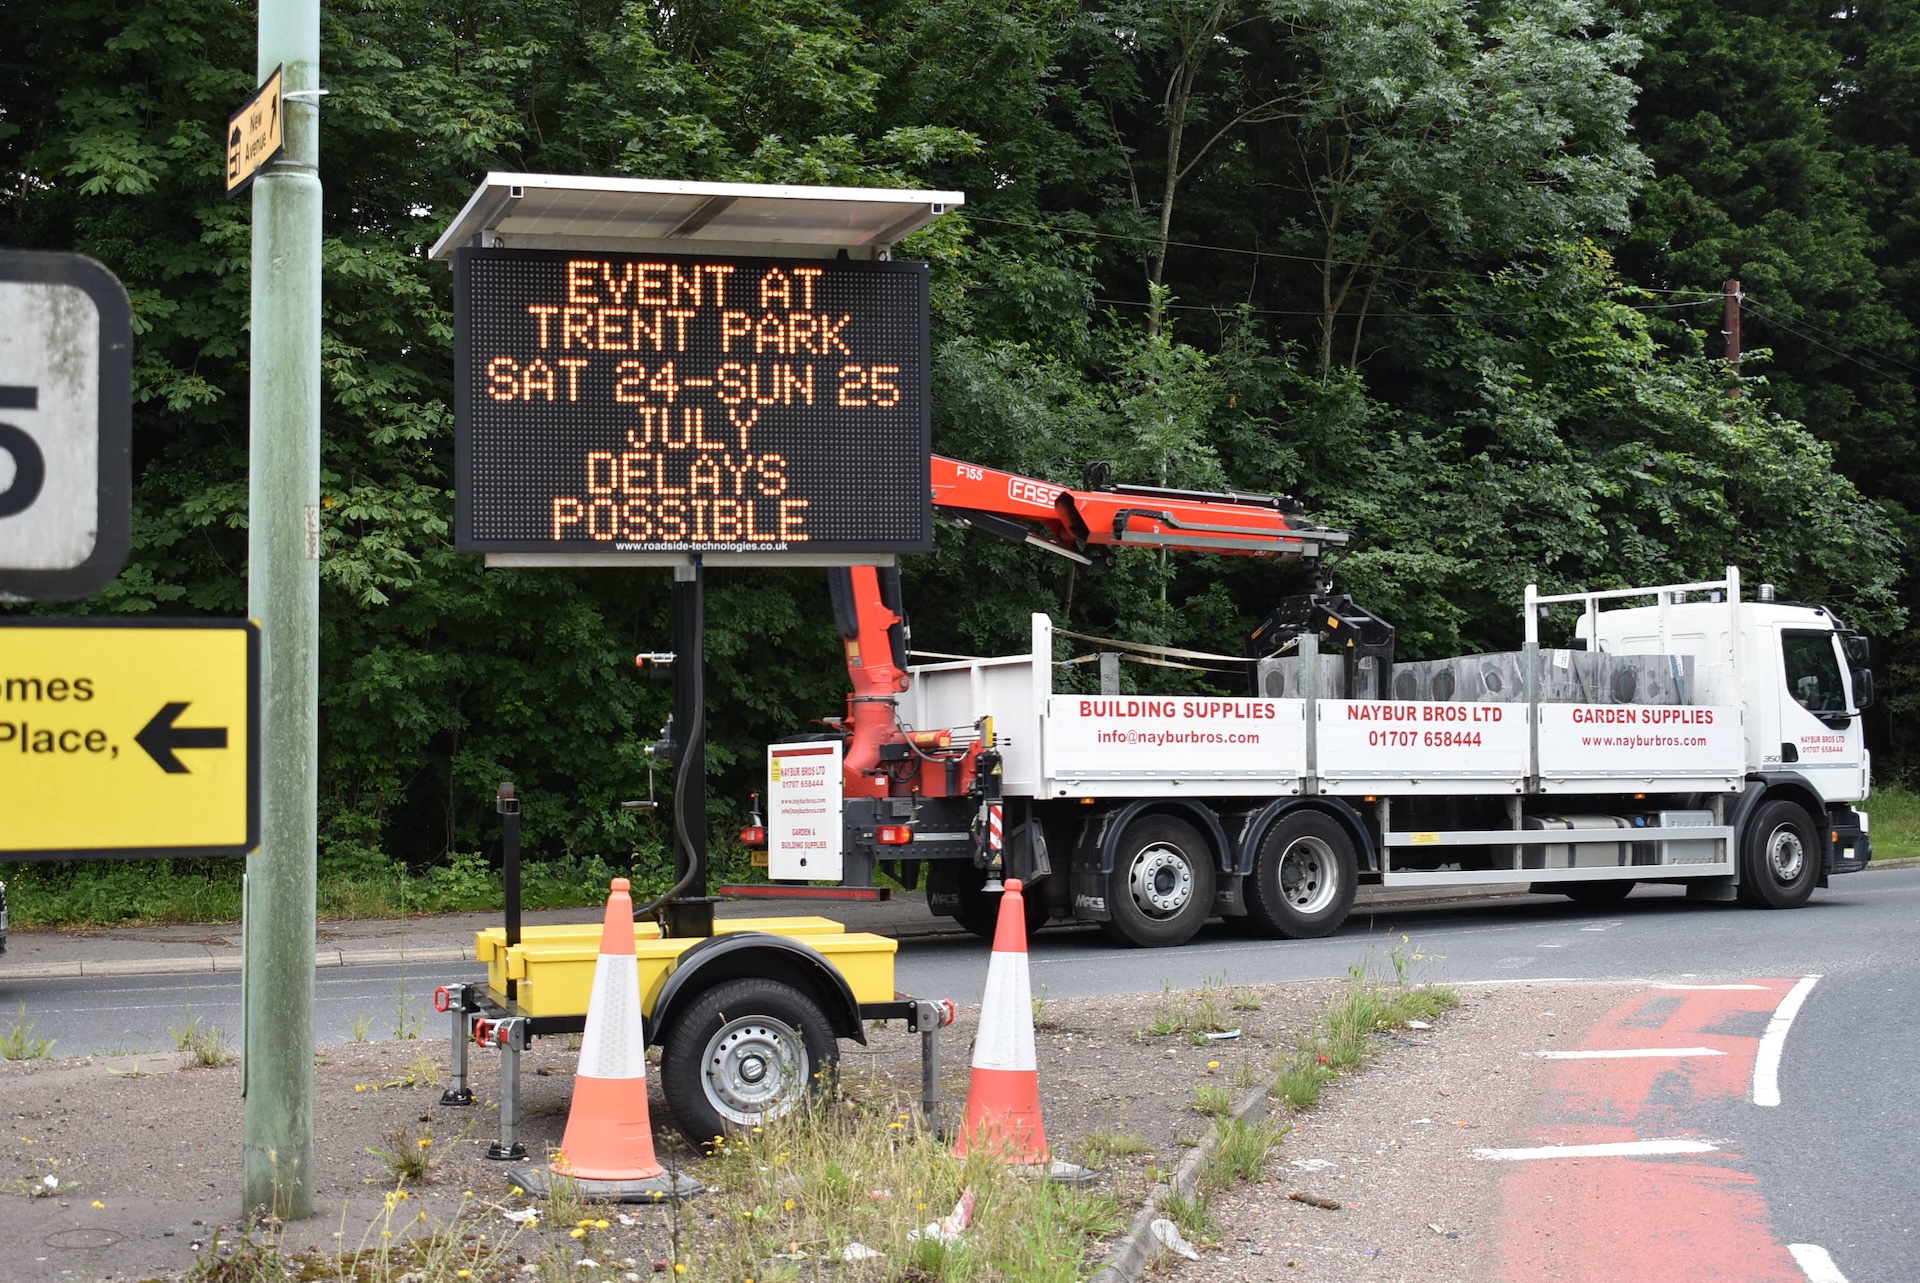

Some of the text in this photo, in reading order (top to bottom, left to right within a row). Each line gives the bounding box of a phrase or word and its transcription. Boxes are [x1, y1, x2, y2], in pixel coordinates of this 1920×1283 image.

[250, 111, 262, 133] New
[245, 132, 266, 162] Avenue
[569, 260, 823, 309] EVENT AT
[528, 306, 851, 355] TRENT PARK
[487, 357, 588, 401] SAT
[837, 365, 900, 407] 25
[627, 406, 758, 450] JULY
[586, 452, 787, 496] DELAYS
[956, 465, 984, 481] F155
[552, 497, 809, 541] POSSIBLE
[615, 541, 788, 553] www.roadside-technologies.co.uk
[0, 676, 95, 702] mes
[1079, 700, 1276, 719] BUILDING SUPPLIES
[1347, 704, 1503, 722] NAYBUR BROS LTD
[1572, 708, 1714, 725] GARDEN SUPPLIES
[0, 721, 119, 760] Place,
[1097, 729, 1260, 747] info@nayburbros.com
[1368, 730, 1482, 747] 01707 658444
[1582, 735, 1707, 749] www.nayburbros.com
[1801, 735, 1845, 743] NAYBUR BROS LTD
[1763, 755, 1781, 763] 350
[1802, 746, 1843, 754] 01707 658444
[780, 767, 801, 777] NAYBUR
[801, 766, 816, 776] BROS
[816, 765, 826, 775] LTD
[782, 779, 824, 788] 01707 658444
[792, 828, 816, 836] GARDEN &
[805, 841, 827, 849] SUPPLIES
